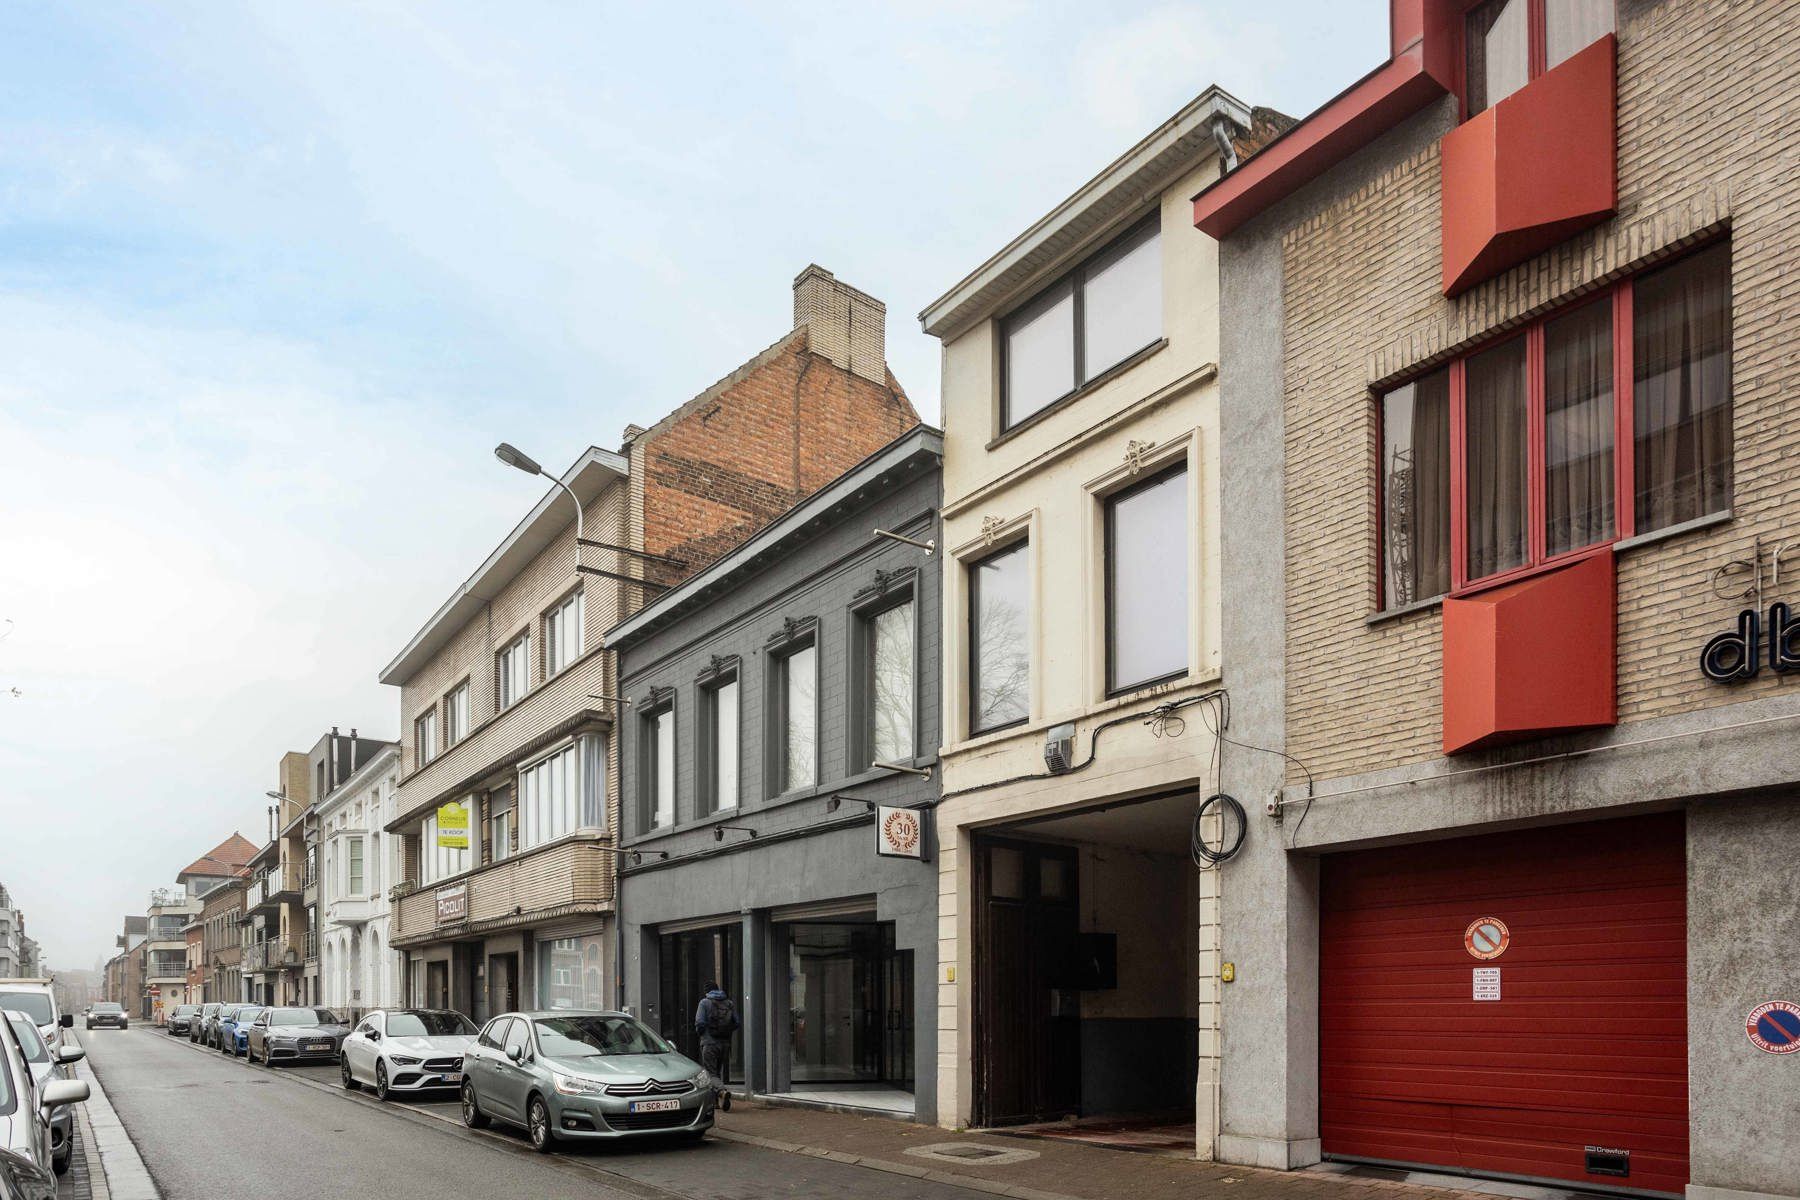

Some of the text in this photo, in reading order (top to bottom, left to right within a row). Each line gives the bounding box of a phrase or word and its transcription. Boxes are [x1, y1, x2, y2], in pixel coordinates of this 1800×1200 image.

[896, 822, 911, 836] 30
[1748, 1003, 1774, 1026] VERBODEN
[1775, 1002, 1784, 1010] TE
[637, 1101, 678, 1111] 1-SCR-417
